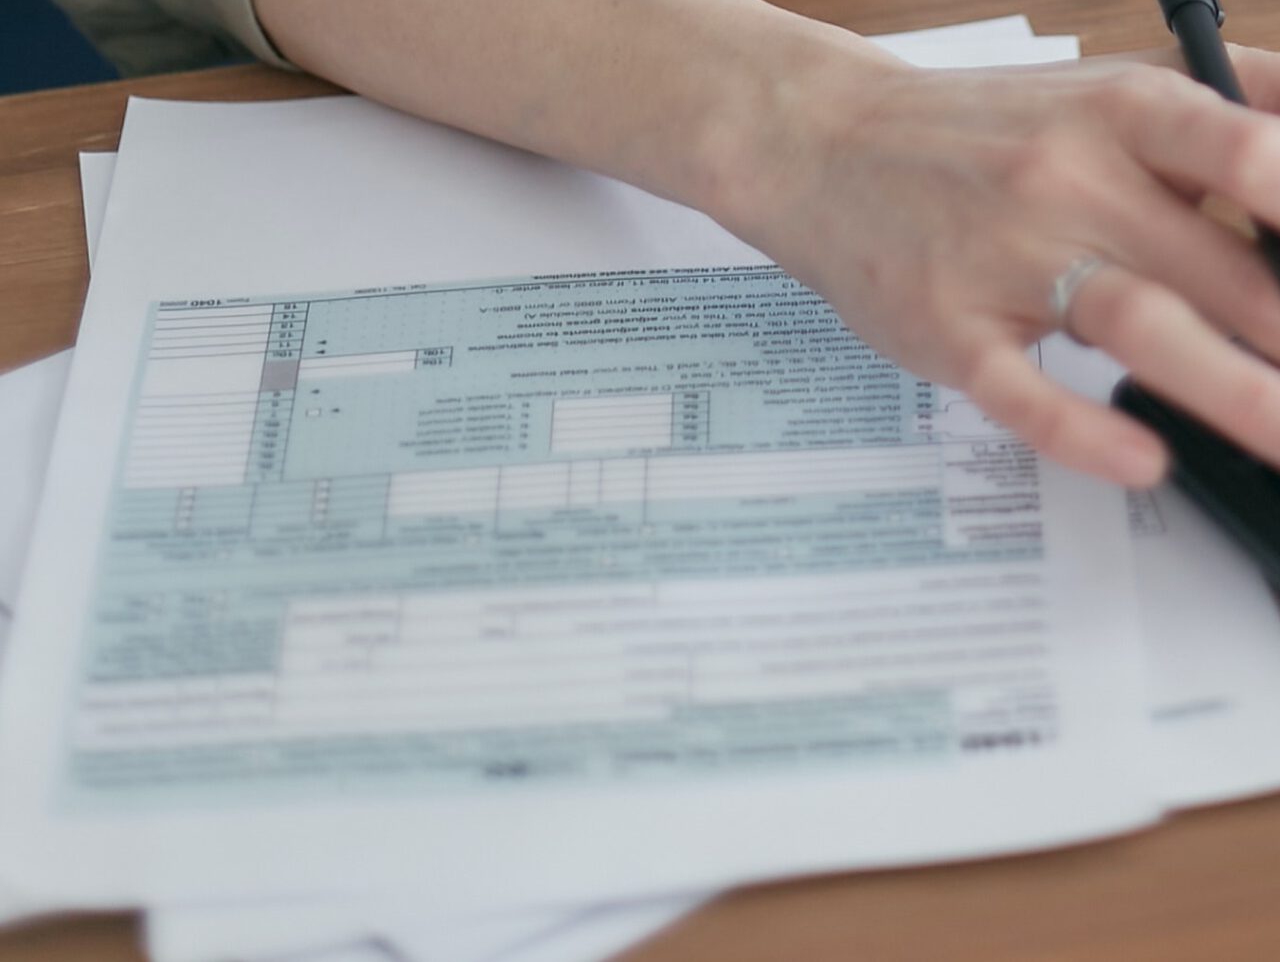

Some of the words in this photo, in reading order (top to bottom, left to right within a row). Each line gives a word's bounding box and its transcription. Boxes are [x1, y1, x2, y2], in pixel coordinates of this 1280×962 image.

[598, 268, 647, 280] separate
[718, 275, 742, 284] line
[648, 278, 671, 288] line
[671, 277, 701, 287] from
[638, 296, 680, 307] Attach
[744, 291, 789, 302] income
[190, 298, 223, 309] 1040
[605, 299, 637, 309] Form
[702, 302, 758, 313] itemized
[538, 310, 595, 321] Schedule
[630, 304, 701, 317] deductions
[516, 320, 564, 331] income
[565, 317, 602, 328] gross
[603, 314, 660, 327] adjusted
[561, 325, 640, 339] adjustments
[641, 325, 672, 335] total
[496, 331, 544, 342] income
[625, 334, 678, 346] standard
